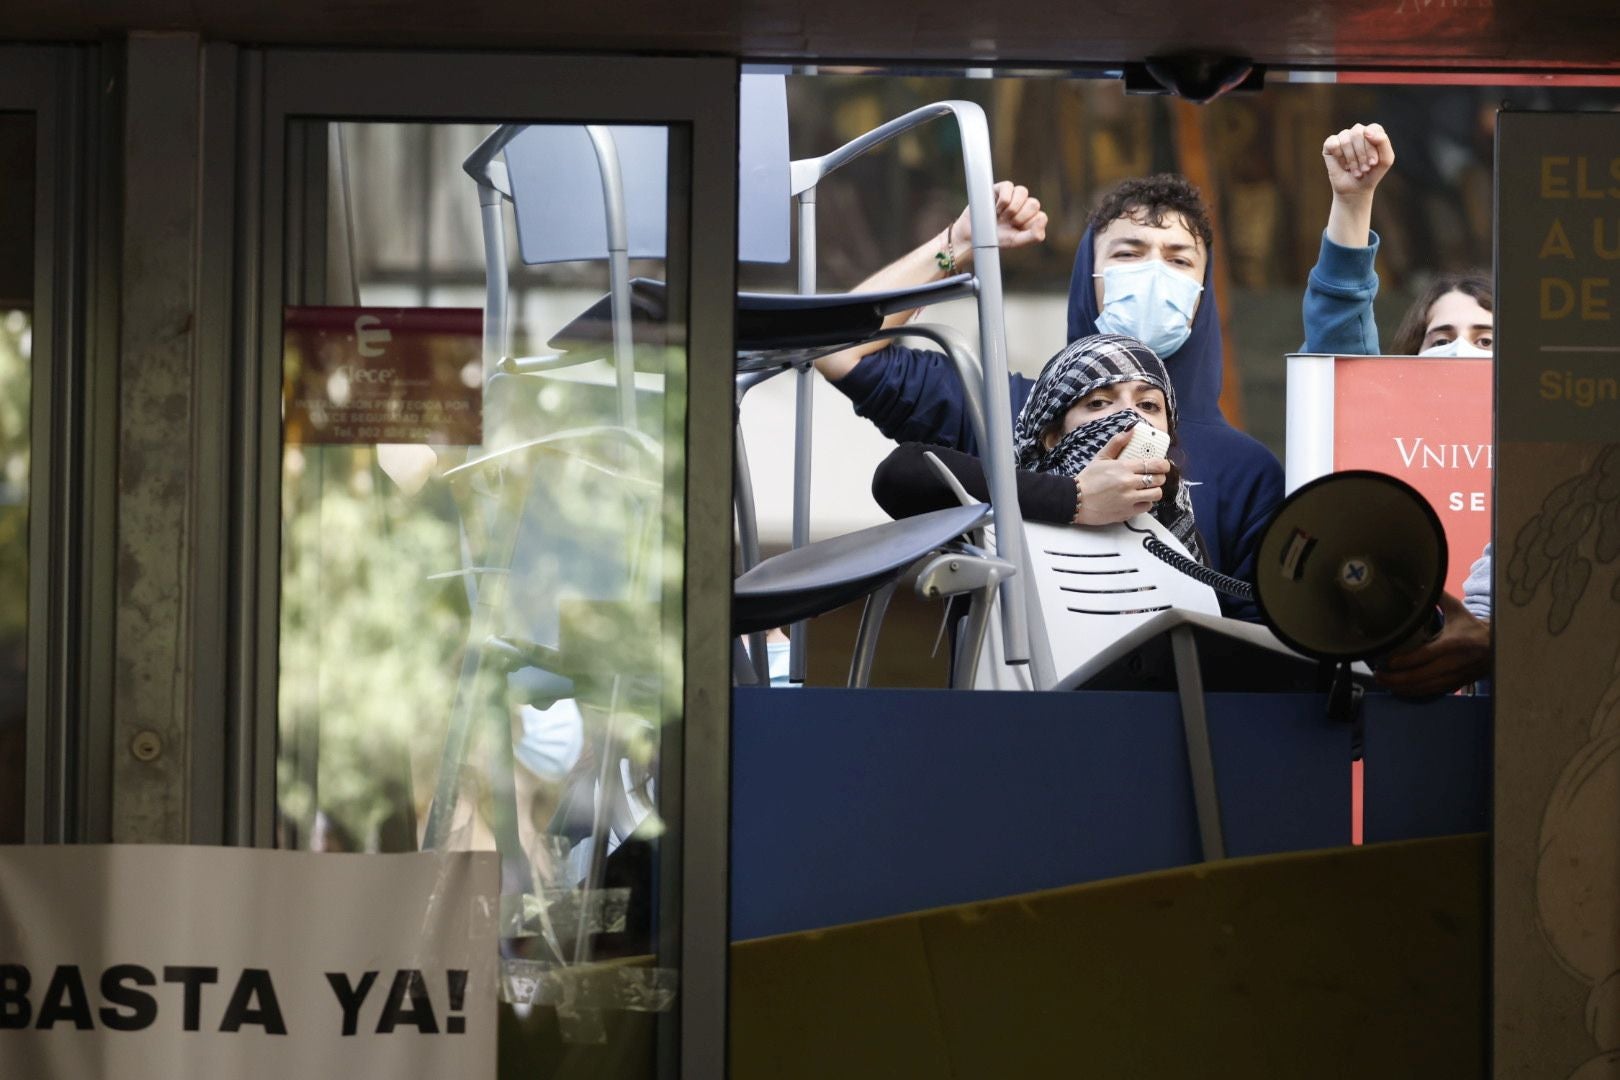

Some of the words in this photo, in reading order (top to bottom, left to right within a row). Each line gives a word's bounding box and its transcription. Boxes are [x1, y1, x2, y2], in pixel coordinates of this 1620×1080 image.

[1538, 217, 1575, 260] A
[1540, 278, 1611, 320] DE
[1539, 369, 1618, 408] Sign
[1449, 491, 1486, 512] SE
[0, 963, 288, 1036] BASTA
[324, 969, 469, 1037] YA!
